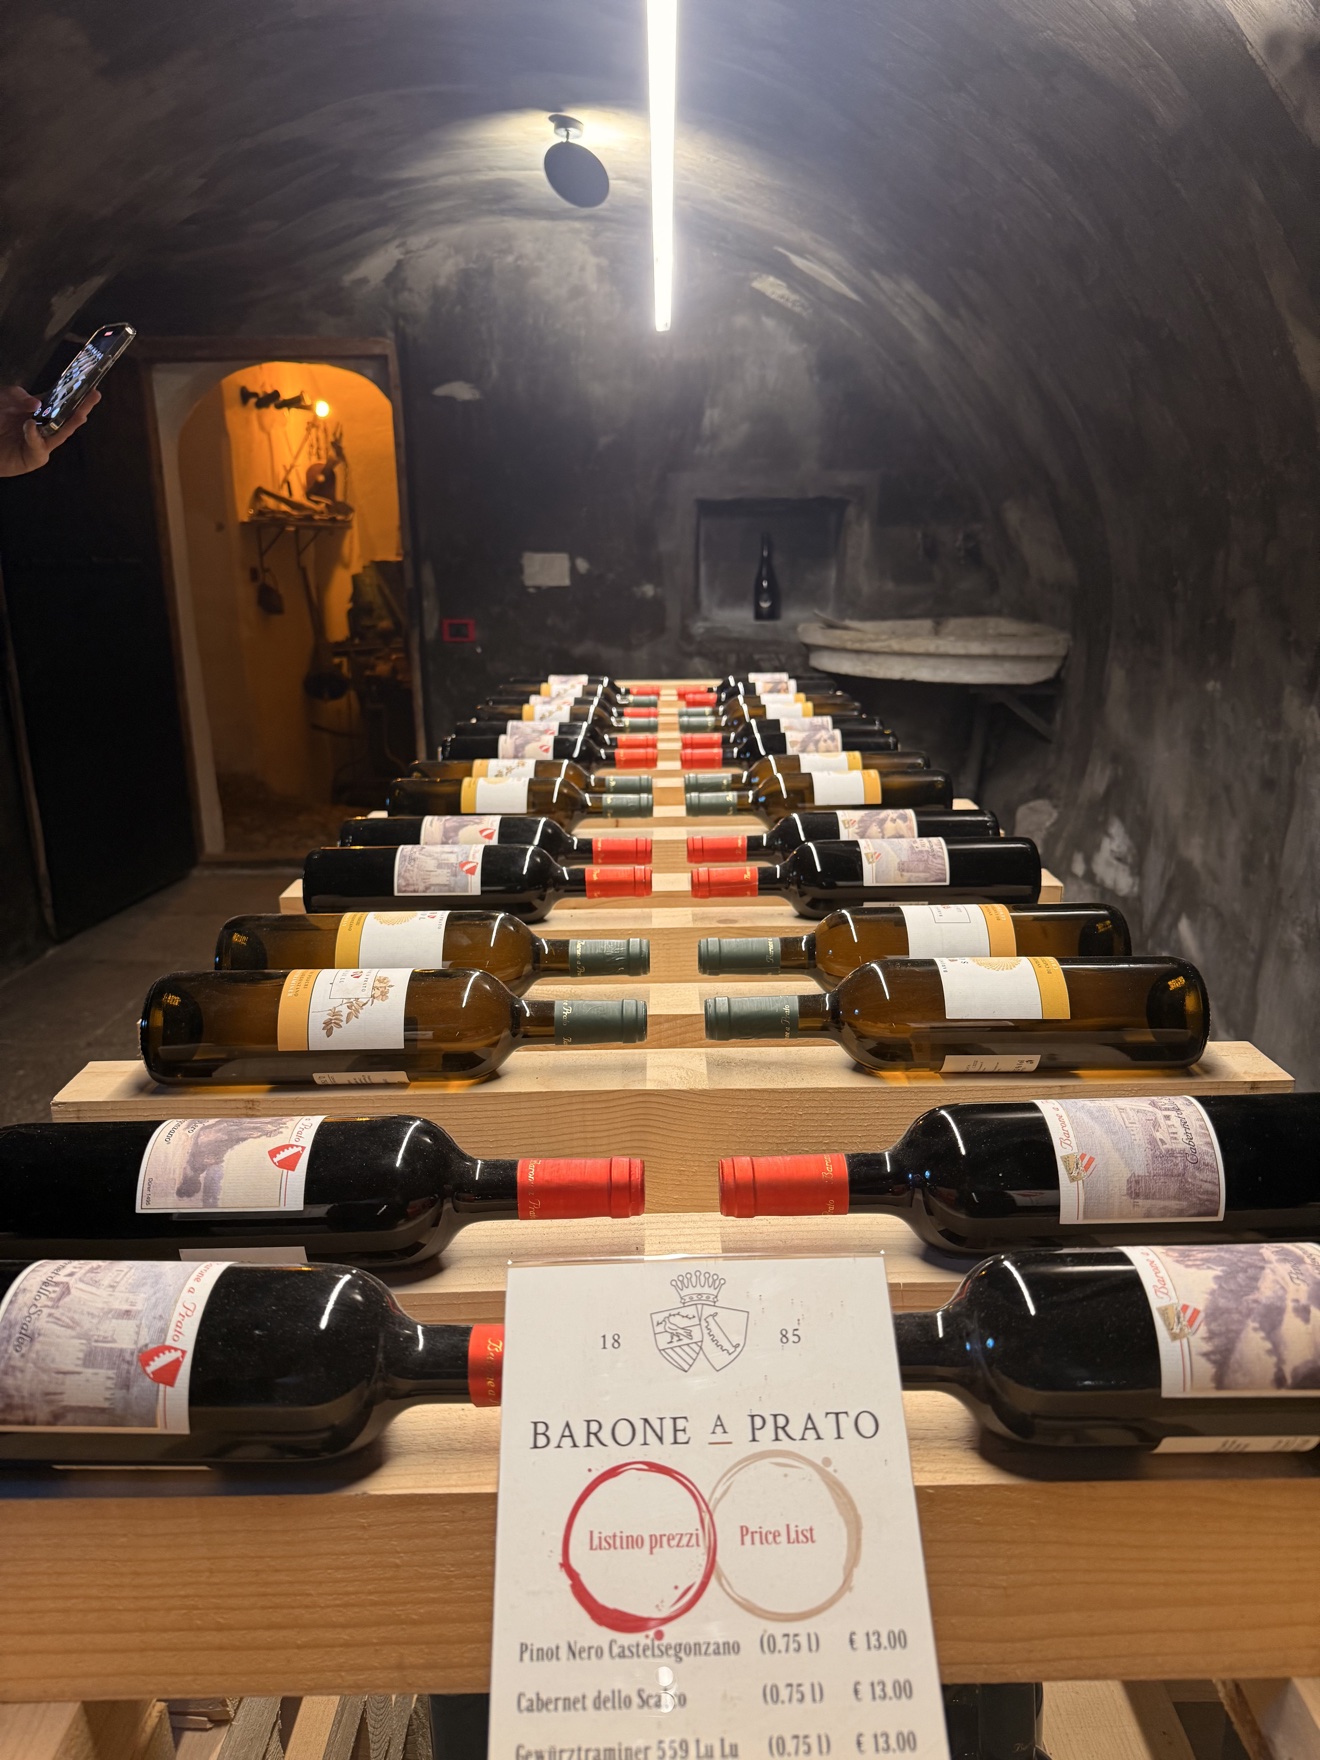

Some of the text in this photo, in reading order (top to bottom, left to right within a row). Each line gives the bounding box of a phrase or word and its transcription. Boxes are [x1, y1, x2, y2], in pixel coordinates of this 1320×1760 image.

[187, 1286, 196, 1294] a
[172, 1302, 197, 1343] Prato
[780, 1328, 801, 1344] 85
[601, 1333, 621, 1350] 18
[530, 1410, 879, 1449] BARONE A PRATO
[589, 1528, 701, 1555] Listino prezzi
[739, 1523, 816, 1546] Price List
[519, 1641, 561, 1662] Pinot
[566, 1640, 604, 1661] Nero
[608, 1637, 741, 1663] Castelsegonzano
[760, 1631, 801, 1654] (0.75
[849, 1631, 858, 1651] €
[865, 1628, 908, 1651] 13.00
[517, 1690, 585, 1713] Cabernet
[593, 1688, 632, 1710] dello
[762, 1682, 805, 1706] (0.75
[853, 1680, 862, 1702] €
[870, 1678, 914, 1702] 13.00
[656, 1738, 689, 1760] 559
[696, 1739, 714, 1759] Lu
[720, 1737, 739, 1759] Lu
[768, 1734, 812, 1758] (0.75
[856, 1732, 866, 1754] €
[873, 1729, 918, 1754] 13.00
